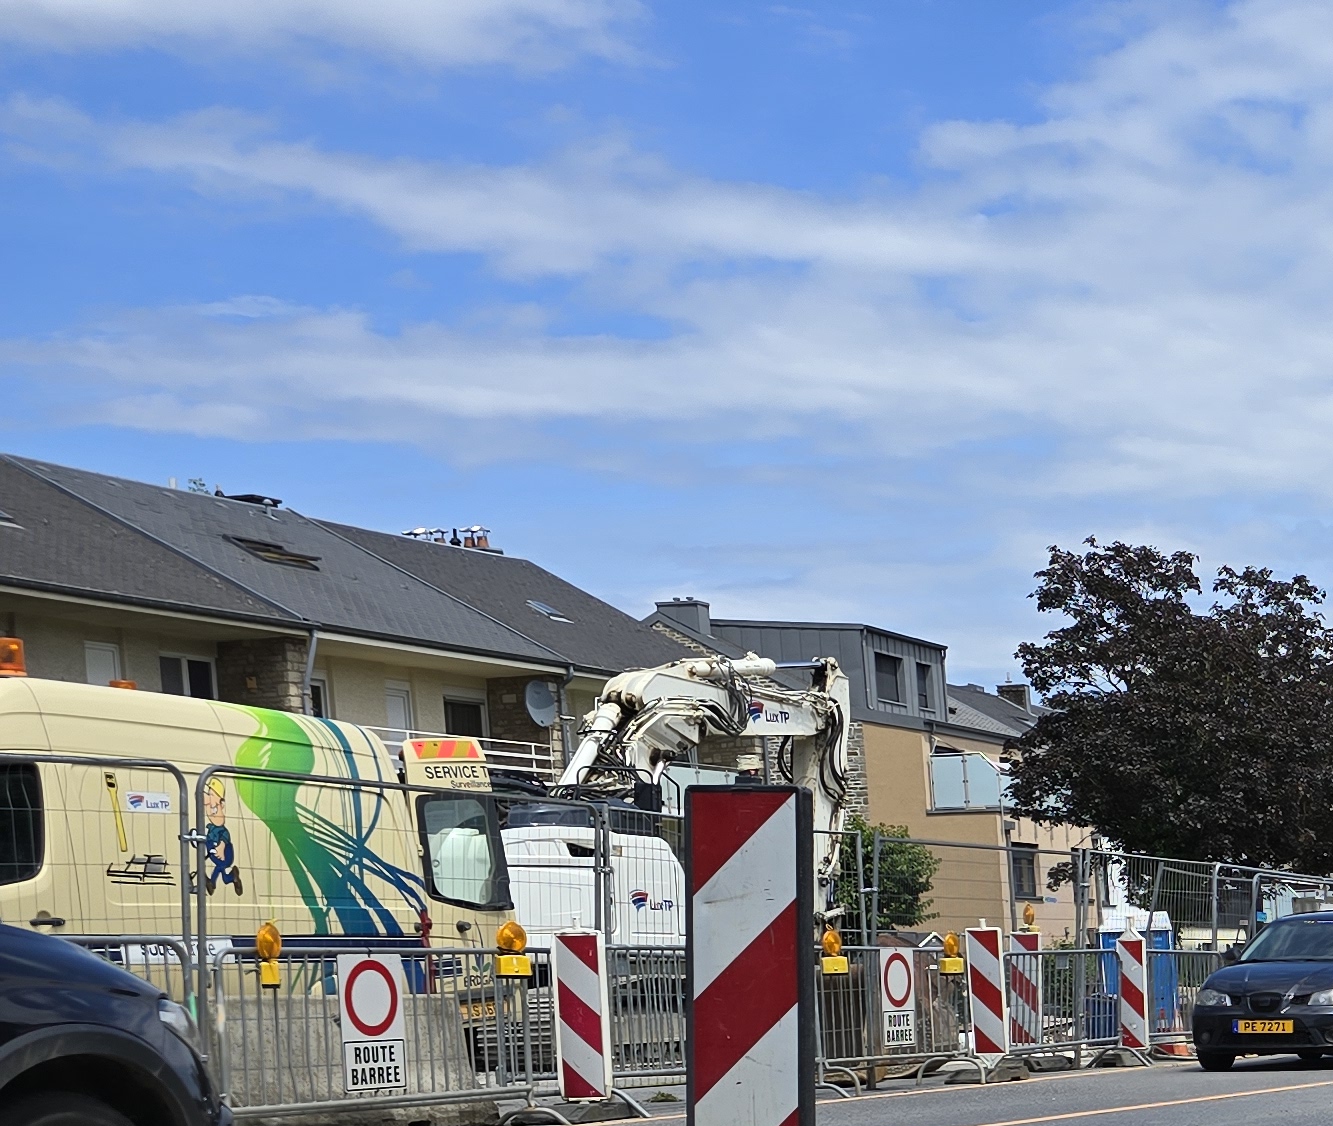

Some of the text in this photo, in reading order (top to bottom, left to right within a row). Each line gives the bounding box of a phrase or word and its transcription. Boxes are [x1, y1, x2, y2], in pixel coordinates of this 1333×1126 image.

[424, 765, 480, 779] SERVICE
[887, 1013, 910, 1028] ROUTE
[1244, 1021, 1258, 1032] PE
[886, 1029, 913, 1043] BARREE
[354, 1045, 396, 1065] ROUTE
[351, 1066, 401, 1086] BARREE
